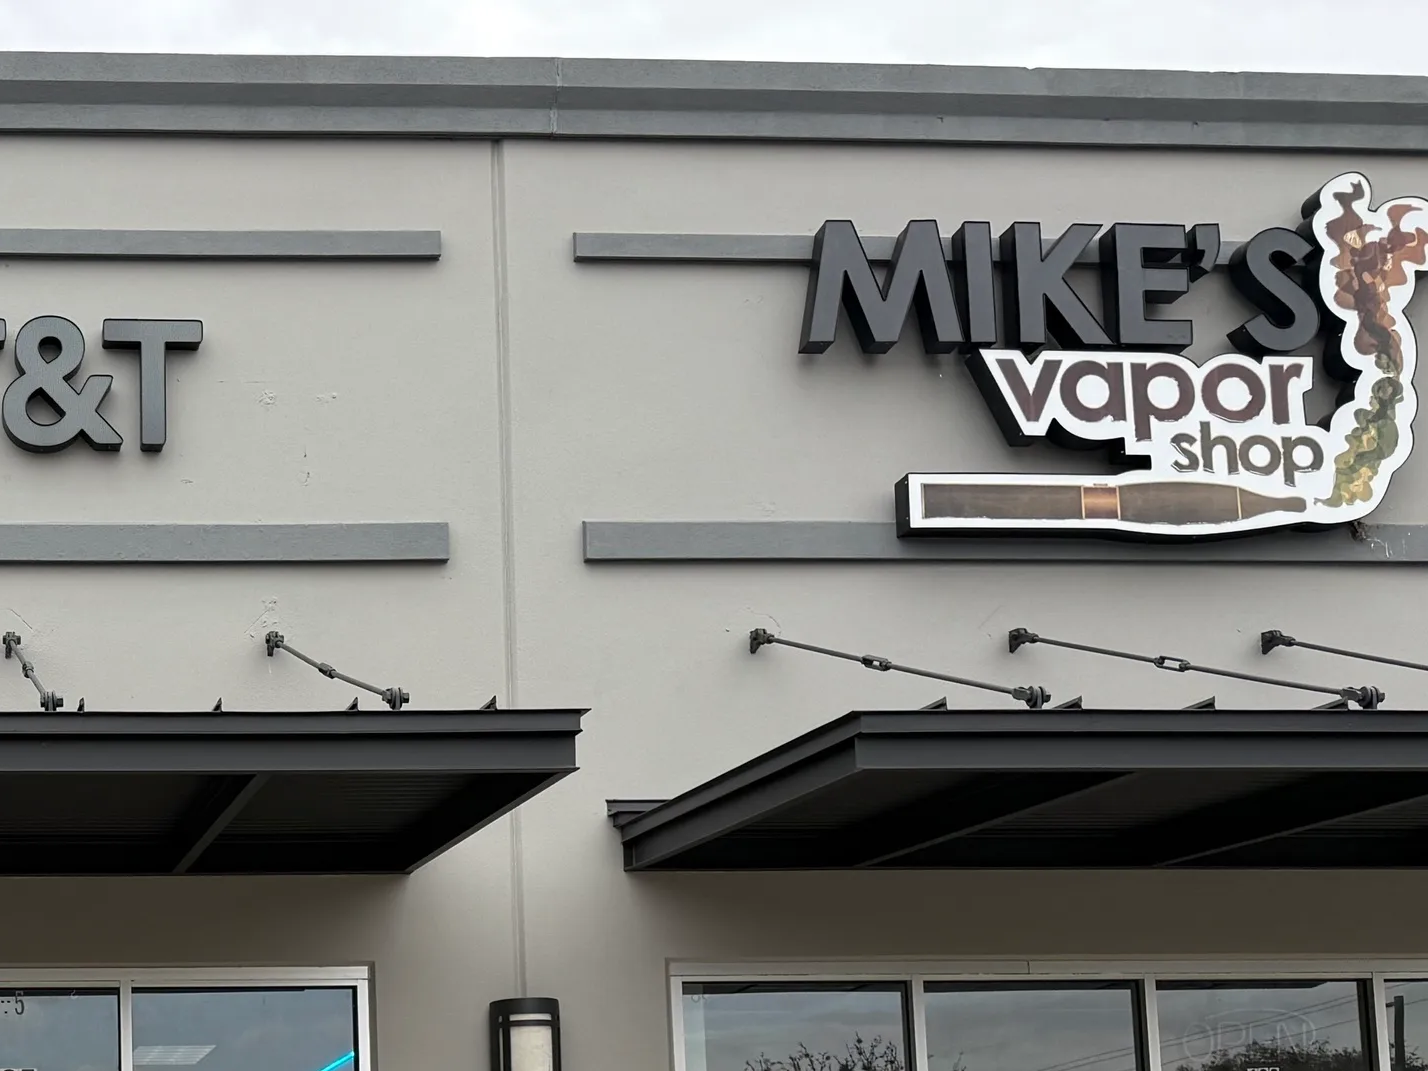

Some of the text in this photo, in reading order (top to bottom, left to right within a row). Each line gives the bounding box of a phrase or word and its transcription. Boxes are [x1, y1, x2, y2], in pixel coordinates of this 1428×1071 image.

[799, 219, 1320, 354] MIKE'S
[995, 356, 1304, 441] vapor
[1170, 420, 1325, 487] shop
